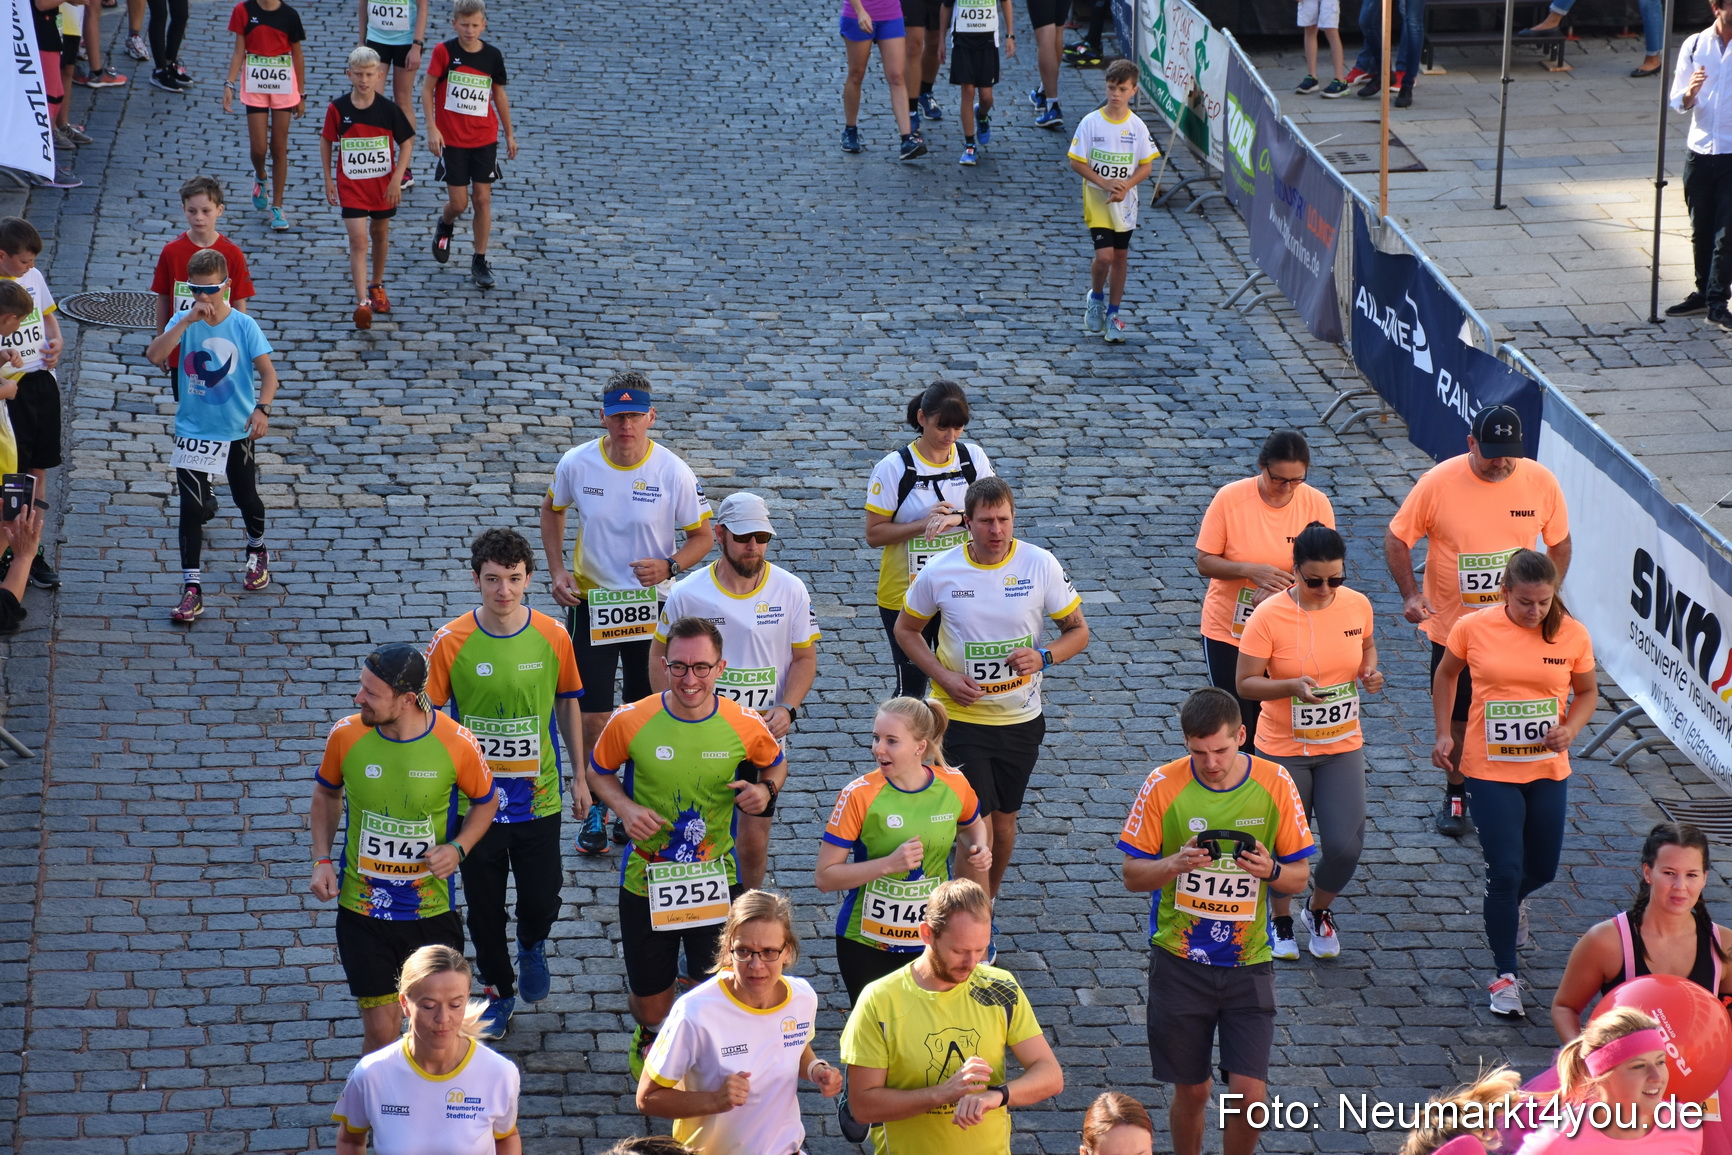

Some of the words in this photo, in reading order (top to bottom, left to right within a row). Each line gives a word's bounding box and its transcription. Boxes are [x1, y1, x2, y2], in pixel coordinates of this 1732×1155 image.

[372, 5, 404, 18] 4012
[961, 9, 992, 20] 4032
[251, 68, 287, 80] 4046
[452, 73, 487, 86] BOCK
[451, 86, 485, 102] 4044
[25, 81, 51, 162] PARTL
[345, 138, 384, 149] BOCK
[348, 151, 386, 165] 4045
[1093, 151, 1130, 163] BOCK
[348, 166, 386, 174] JONATHAN
[1093, 163, 1128, 178] 4038
[1, 326, 40, 347] 4016
[20, 348, 36, 357] EON
[177, 437, 222, 456] 4057
[914, 534, 966, 550] BOCK
[1004, 577, 1017, 585] 20
[1467, 572, 1502, 590] 524
[594, 590, 651, 604] BOCK
[756, 604, 768, 612] 20
[598, 606, 650, 625] 5088
[1630, 548, 1721, 686] swn
[602, 627, 647, 638] MICHAEL
[518, 662, 543, 670] BOCK
[974, 662, 1014, 680] 521
[980, 679, 1022, 693] FLORIAN
[1630, 620, 1688, 692] stadtwerke
[1688, 678, 1732, 748] neumark
[715, 688, 769, 707] 5217
[1301, 702, 1352, 726] 5287
[1491, 701, 1552, 717] BOCK
[470, 719, 533, 734] BOCK
[1495, 720, 1551, 740] 5160
[476, 738, 531, 757] 5253
[1501, 745, 1547, 754] BETTINA
[1124, 767, 1166, 837] BOCK
[931, 813, 954, 823] BOCK
[1236, 818, 1265, 827] BOCK
[368, 817, 434, 837] BOCK
[367, 836, 430, 859] 5142
[374, 862, 419, 873] VITALIJ
[654, 862, 719, 881] BOCK
[873, 880, 934, 898] BOCK
[1186, 873, 1250, 898] 5145
[659, 881, 720, 907] 5252
[1192, 900, 1239, 913] LASZLO
[880, 926, 919, 938] LAURA
[782, 1020, 796, 1032] 20
[721, 1044, 748, 1054] BOCK
[448, 1092, 464, 1103] 20
[381, 1104, 409, 1113] BOCK
